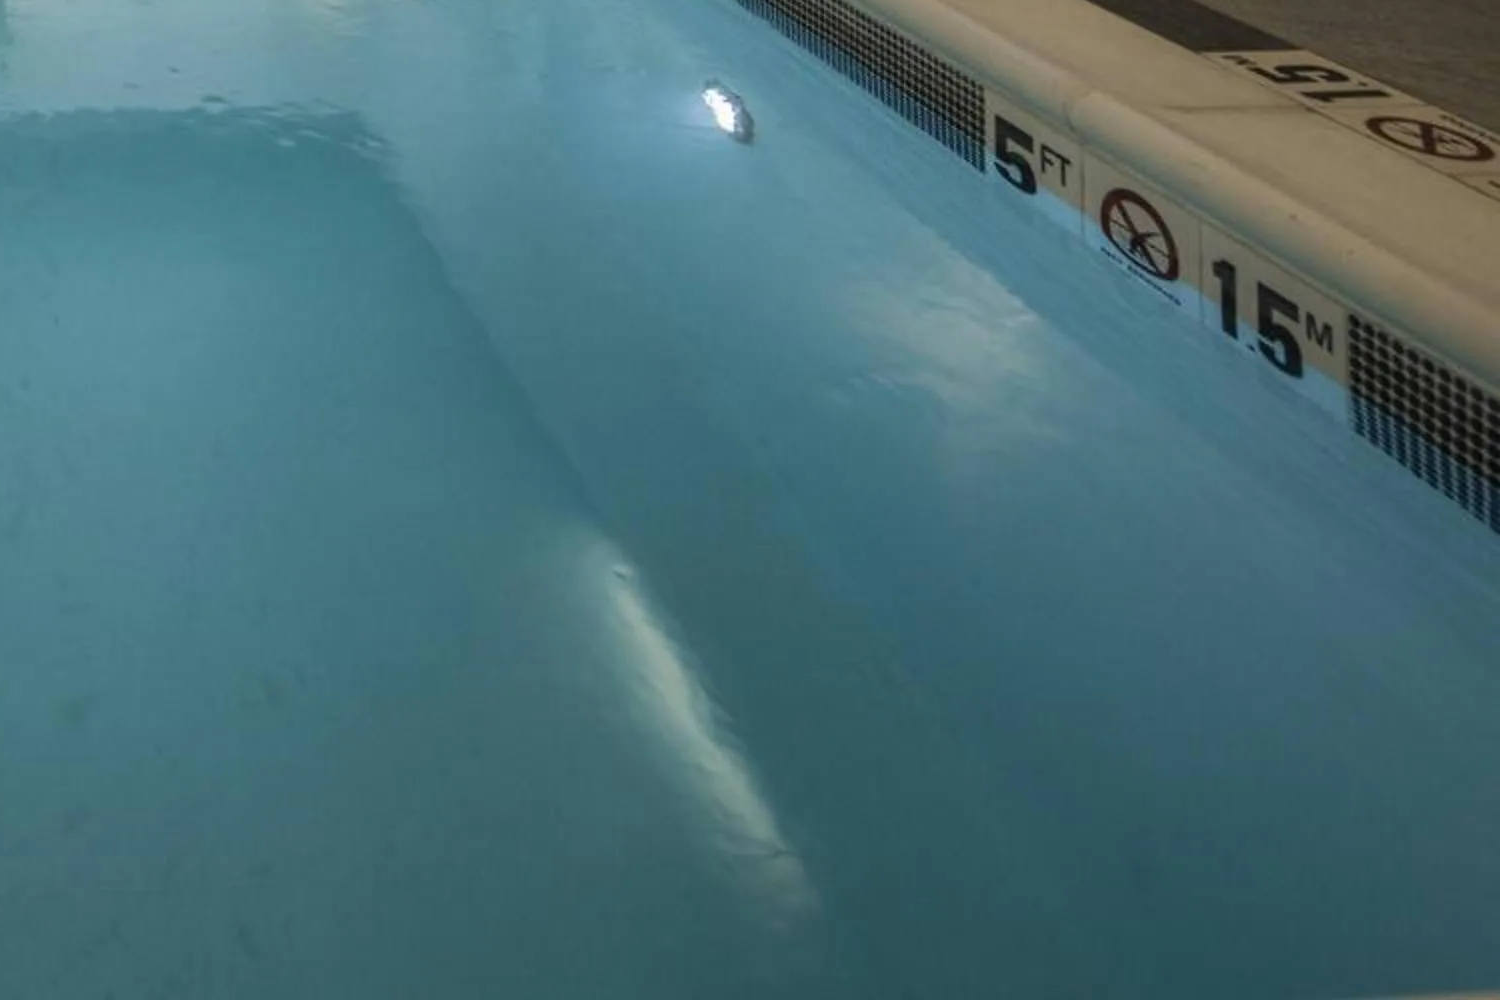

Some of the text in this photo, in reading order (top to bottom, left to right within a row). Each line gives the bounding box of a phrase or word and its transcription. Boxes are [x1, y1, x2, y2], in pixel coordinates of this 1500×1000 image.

[994, 115, 1071, 195] 5 FT
[1306, 312, 1334, 355] M
